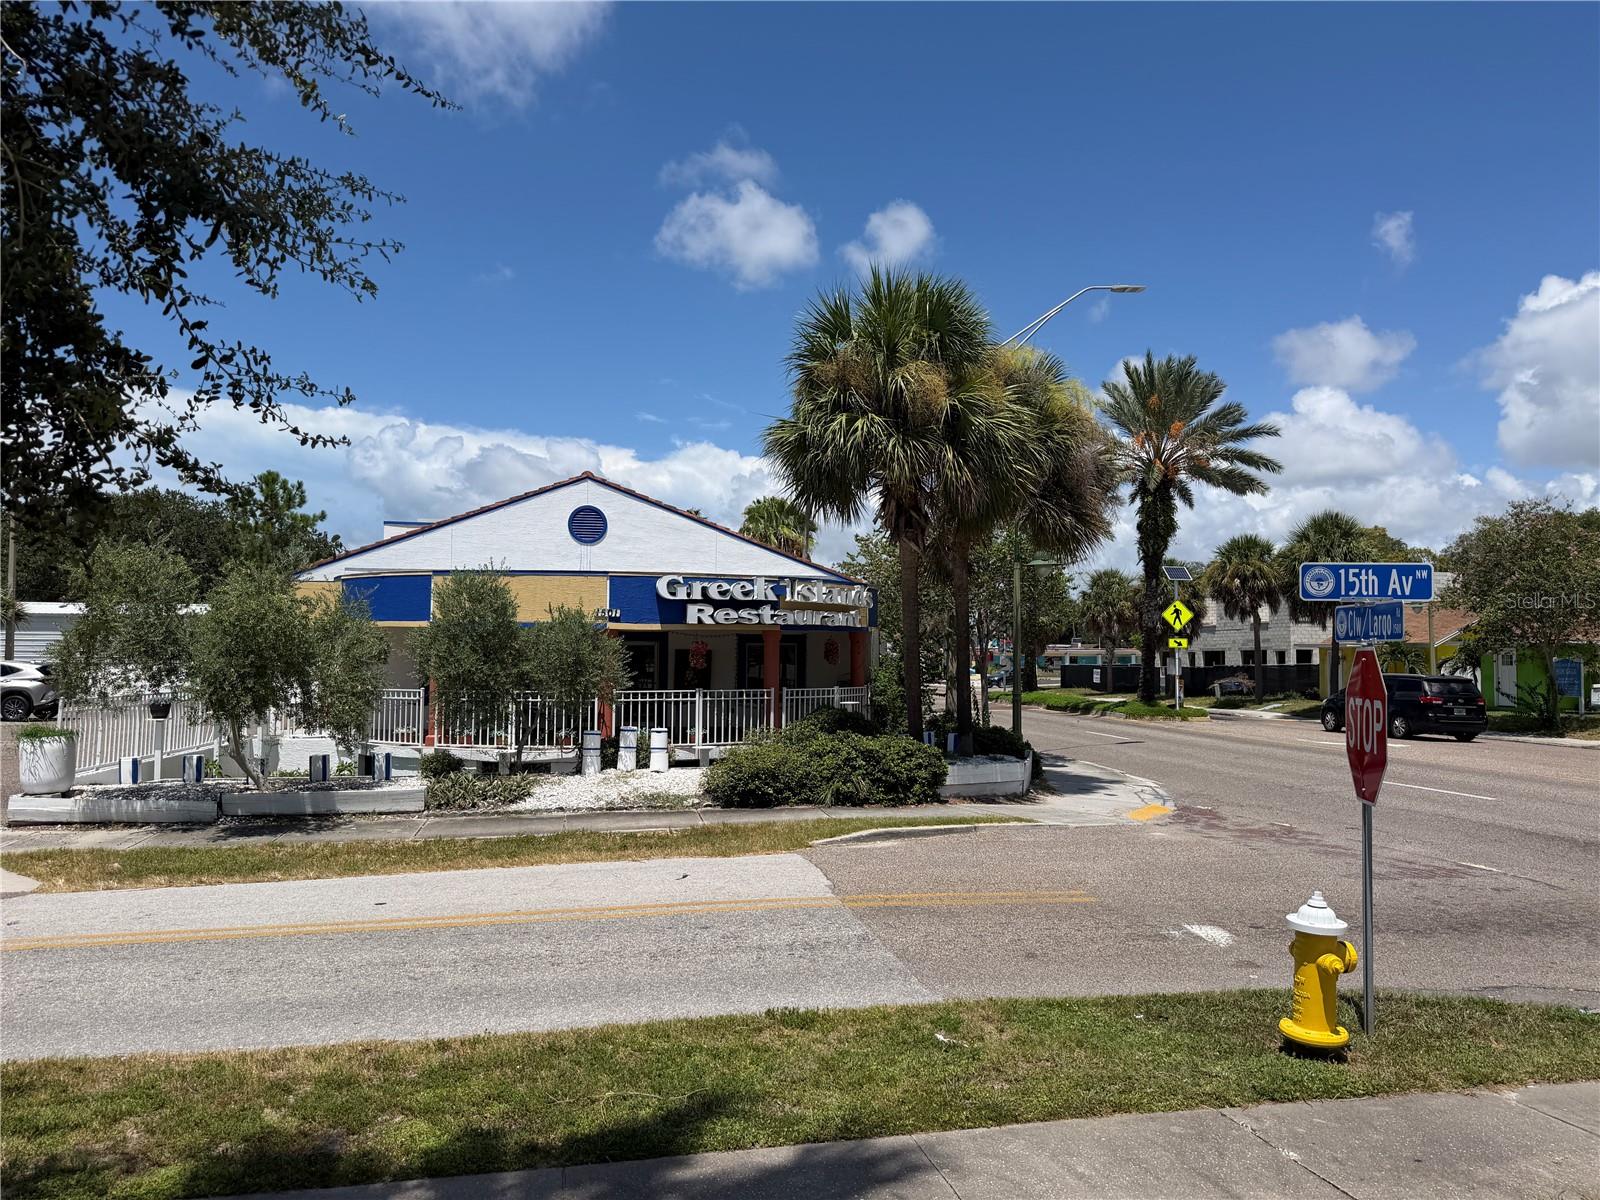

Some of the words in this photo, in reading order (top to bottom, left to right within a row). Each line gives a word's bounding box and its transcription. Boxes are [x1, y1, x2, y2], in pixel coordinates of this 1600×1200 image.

[655, 575, 780, 601] Greek
[784, 578, 874, 608] Islands
[1338, 568, 1379, 596] 15th
[1387, 568, 1413, 596] Av
[1415, 569, 1428, 580] NW
[686, 603, 861, 628] Restaurant
[1348, 608, 1392, 639] Clw/Largo
[1348, 696, 1383, 755] STOP
